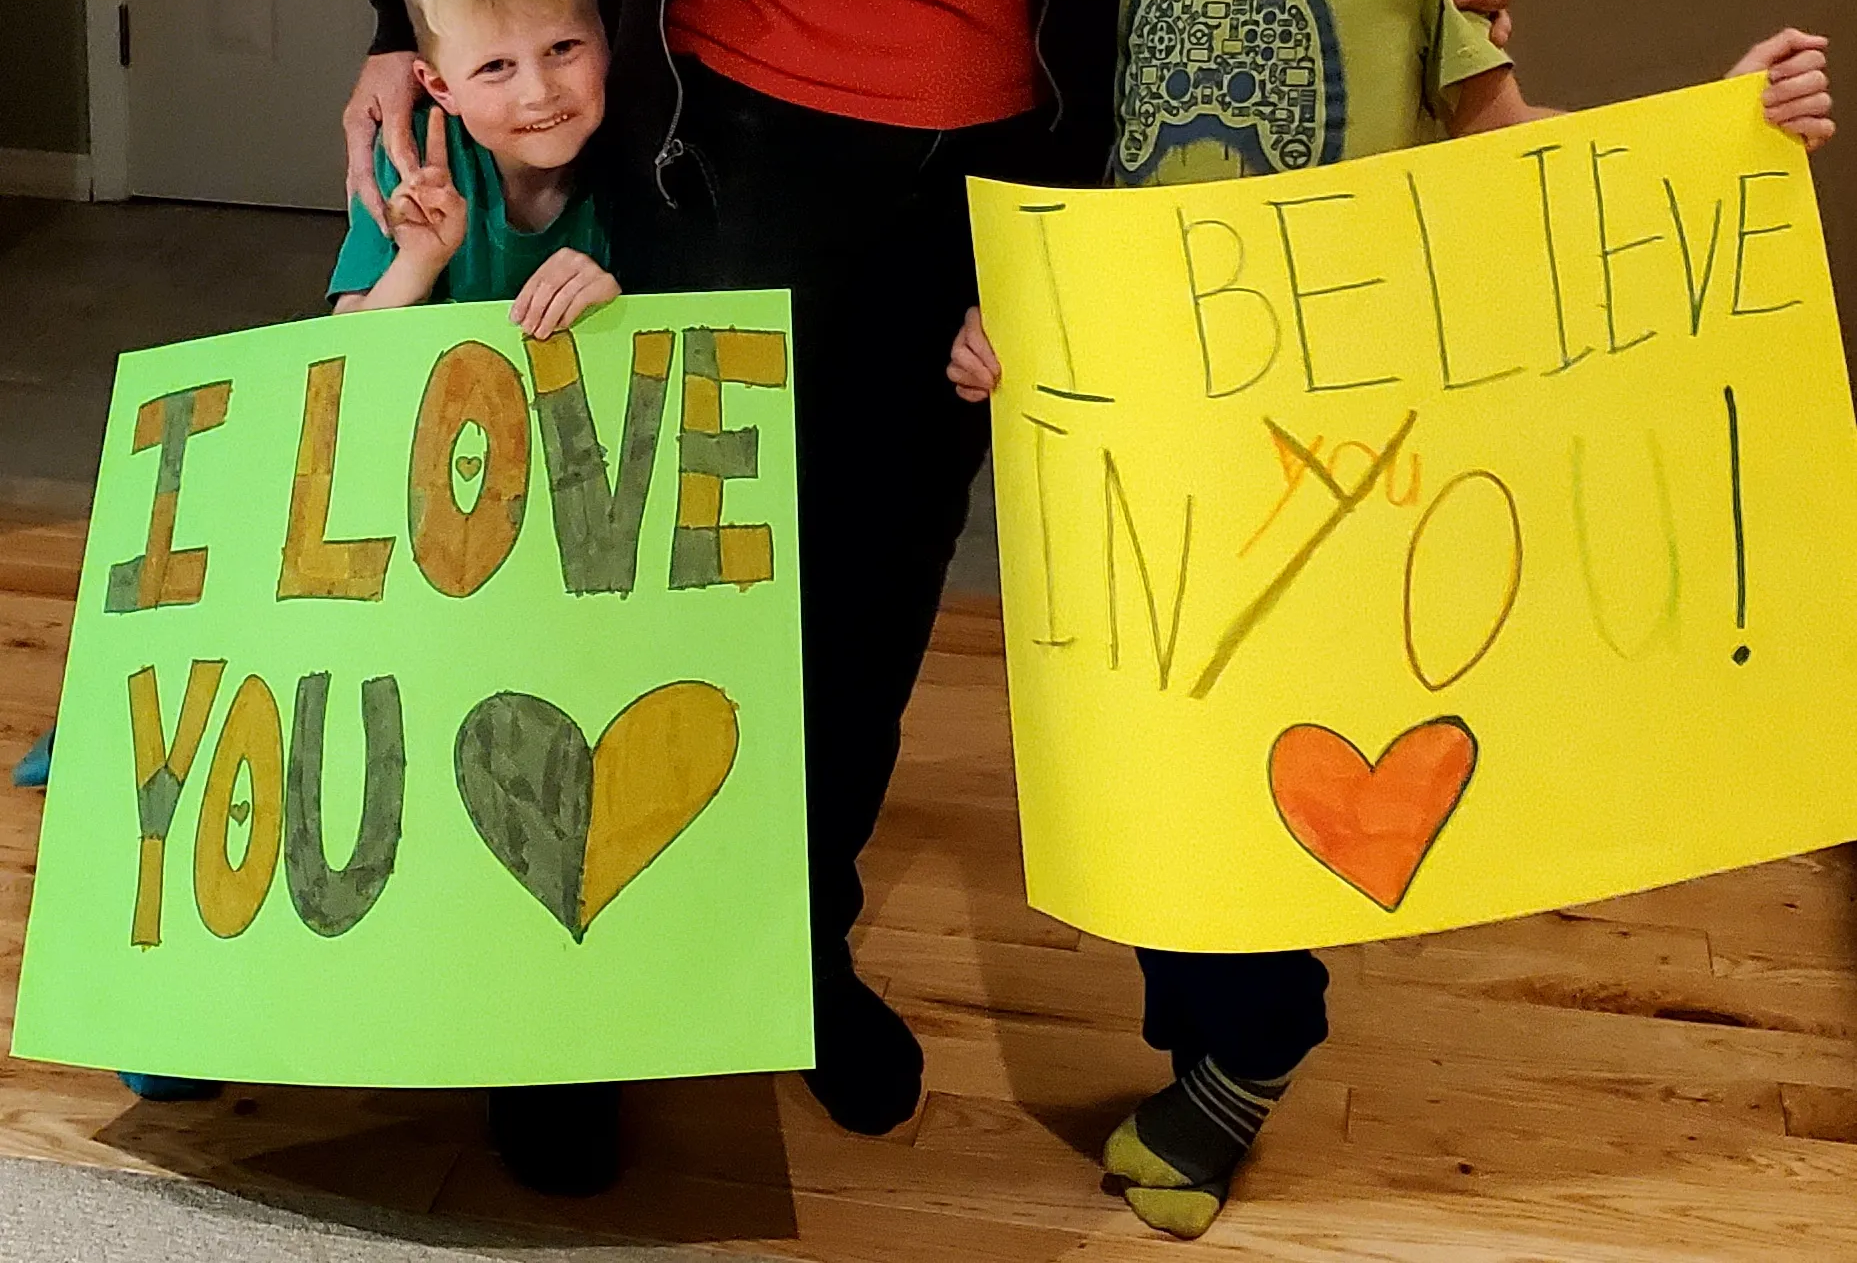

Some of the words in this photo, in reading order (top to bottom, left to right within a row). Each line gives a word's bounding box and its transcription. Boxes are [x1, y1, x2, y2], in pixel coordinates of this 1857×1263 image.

[1018, 203, 1115, 404] I
[1176, 141, 1803, 400] BELIEVE
[104, 380, 233, 613] I
[276, 327, 788, 601] LOVE
[1022, 413, 1194, 691] IN
[127, 659, 407, 951] YOU
